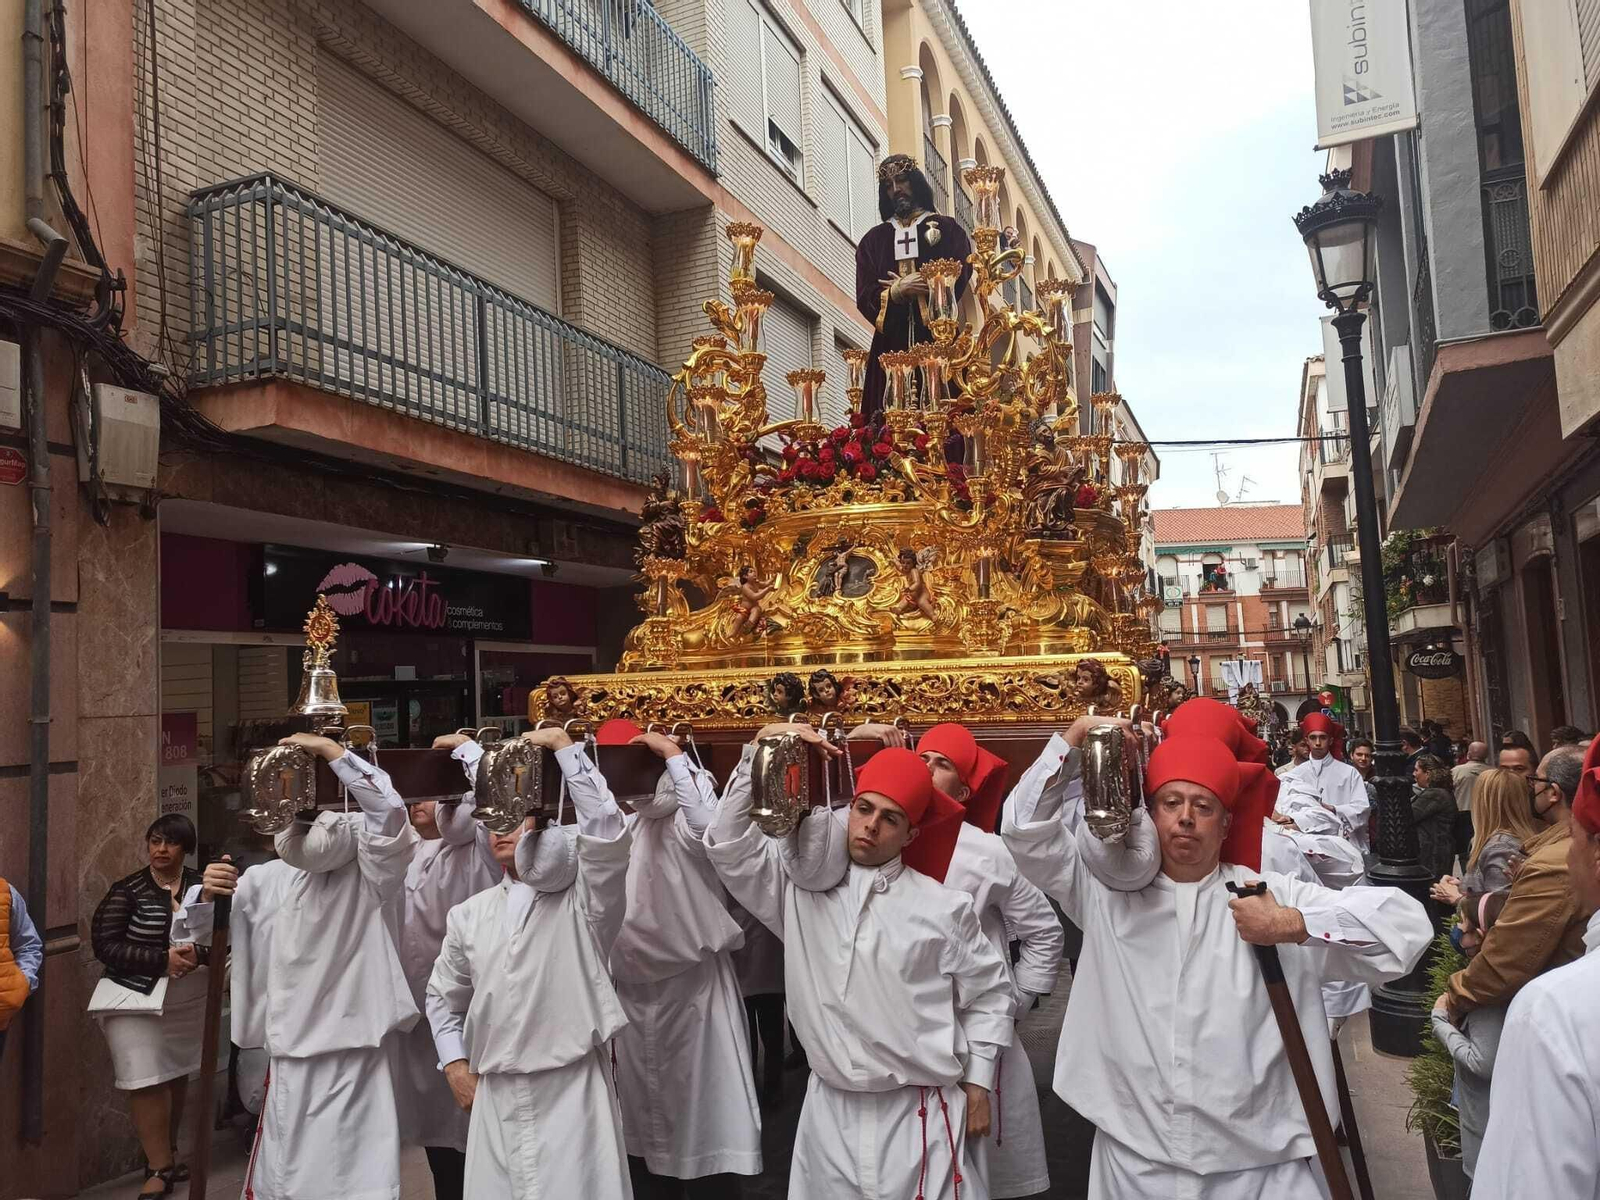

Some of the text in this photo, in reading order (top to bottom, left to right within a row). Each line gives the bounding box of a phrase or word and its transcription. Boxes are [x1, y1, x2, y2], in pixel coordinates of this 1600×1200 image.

[1346, 0, 1369, 75] subin
[453, 618, 503, 631] complementos
[1410, 652, 1451, 667] Coca-Cola
